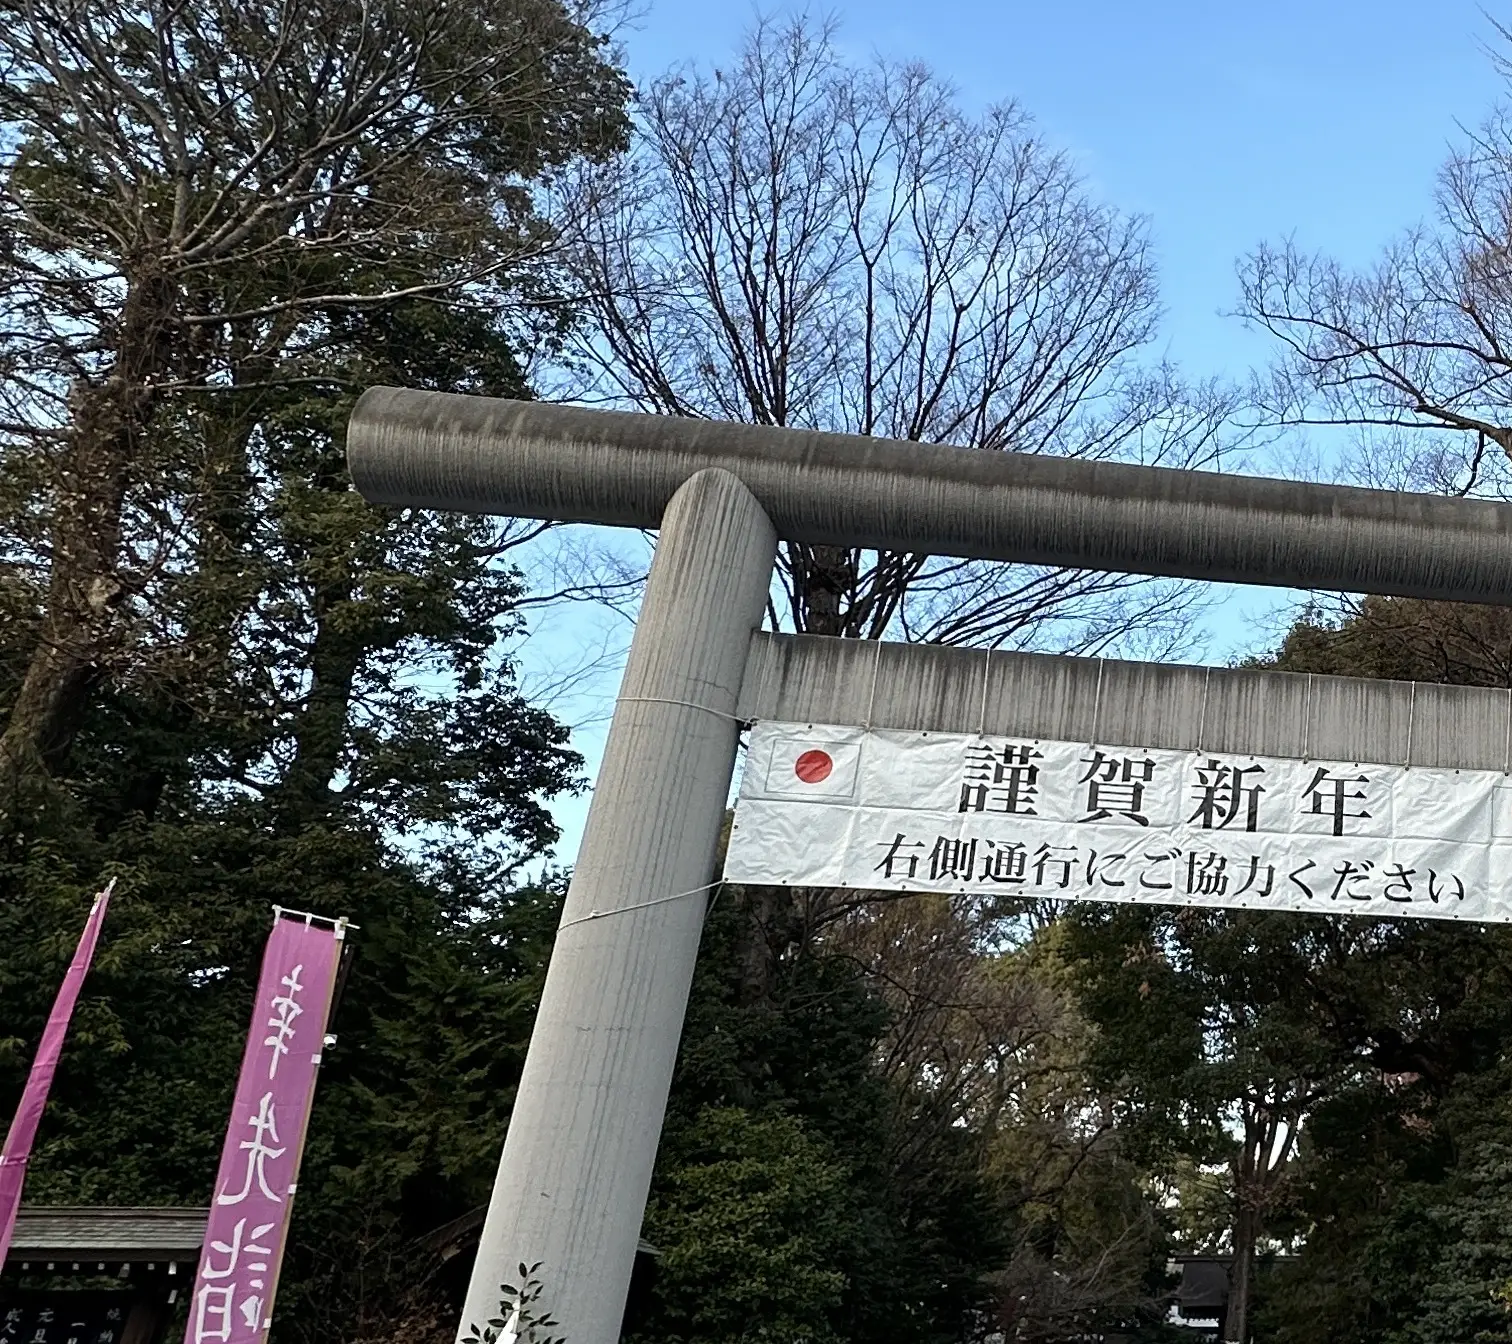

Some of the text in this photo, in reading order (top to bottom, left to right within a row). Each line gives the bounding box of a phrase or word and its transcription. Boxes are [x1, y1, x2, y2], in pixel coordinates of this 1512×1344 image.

[957, 743, 1376, 838] 謹賀新年
[873, 831, 1468, 906] 右側通行にご協力ください
